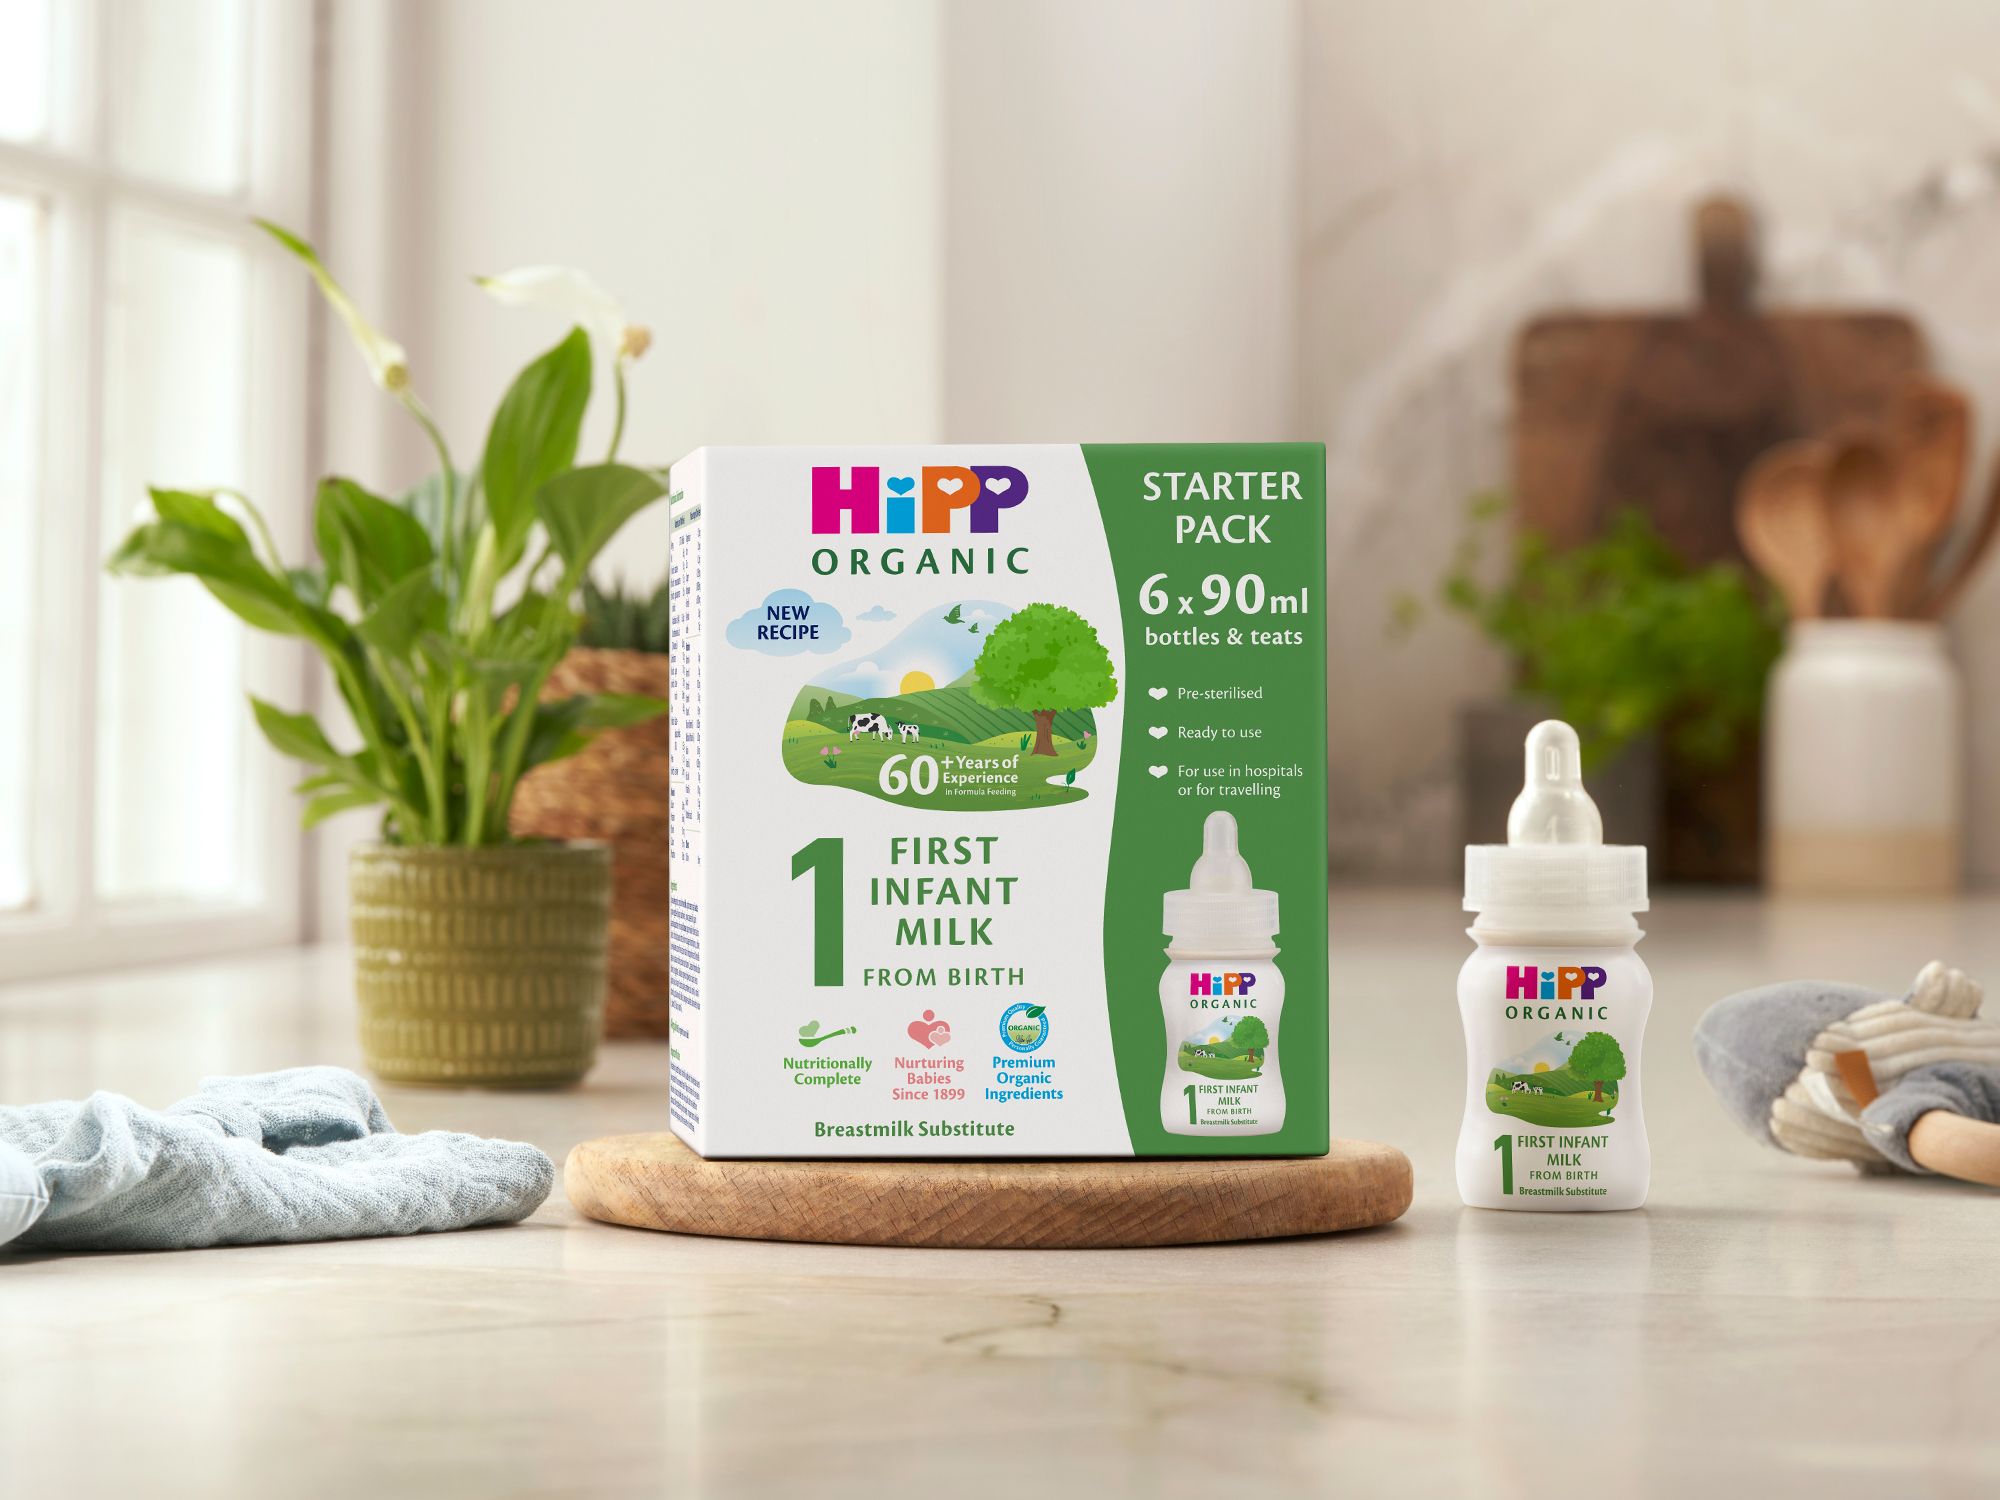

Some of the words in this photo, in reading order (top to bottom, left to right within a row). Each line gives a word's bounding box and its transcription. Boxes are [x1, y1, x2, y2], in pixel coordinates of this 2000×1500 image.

[1142, 471, 1303, 500] STARTER
[812, 465, 1029, 534] HiPP
[1176, 515, 1271, 544] PACK
[812, 547, 1029, 575] ORGANIC
[1139, 573, 1169, 615] 6
[1178, 597, 1194, 615] x
[767, 605, 809, 621] NEW
[757, 624, 819, 641] RECIPE
[1145, 627, 1220, 645] bottles
[1227, 628, 1243, 645] &
[1251, 629, 1303, 645] teats
[1178, 687, 1263, 700] Pre-sterilised
[1178, 726, 1217, 741] Ready
[1222, 728, 1236, 739] to
[1240, 729, 1262, 739] use
[1002, 754, 1019, 769] of
[943, 772, 1018, 786] Experience
[1178, 765, 1199, 777] For
[1203, 767, 1225, 777] use
[1229, 765, 1241, 777] in
[1245, 764, 1303, 780] hospitals
[945, 788, 953, 796] in
[954, 788, 985, 796] Formula
[987, 788, 1017, 797] Feeding
[1178, 786, 1193, 796] or
[1196, 783, 1215, 796] for
[1219, 783, 1281, 799] travelling
[890, 836, 999, 865] FIRST
[871, 877, 1019, 905] INFANT
[791, 837, 844, 987] 1
[895, 918, 994, 946] MILK
[864, 968, 937, 987] FROM
[949, 967, 1025, 986] BIRTH
[1190, 973, 1256, 995] HiPP
[1505, 966, 1607, 1000] HiPP
[1190, 999, 1257, 1009] ORGANIC
[1505, 1006, 1608, 1020] ORGANIC
[783, 1057, 873, 1072] Nutritionally
[894, 1056, 965, 1072] Nurturing
[992, 1056, 1056, 1069] Premium
[794, 1073, 861, 1088] Complete
[907, 1072, 952, 1085] Babies
[996, 1072, 1052, 1087] Organic
[892, 1088, 929, 1101] Since
[934, 1088, 966, 1100] 1899
[985, 1087, 1064, 1103] Ingredients
[1199, 1085, 1222, 1094] FIRST
[1225, 1085, 1258, 1093] INFANT
[1184, 1085, 1197, 1125] 1
[1218, 1096, 1241, 1105] MILK
[815, 1120, 914, 1137] Breastmilk
[918, 1121, 1015, 1137] Substitute
[1518, 1135, 1555, 1148] FIRST
[1559, 1135, 1608, 1148] INFANT
[1494, 1134, 1514, 1195] 1
[1547, 1154, 1581, 1166] MILK
[1529, 1171, 1562, 1180] FROM
[1566, 1170, 1598, 1180] BIRTH
[1519, 1186, 1564, 1196] Breastmilk
[1565, 1187, 1607, 1196] Substitute
